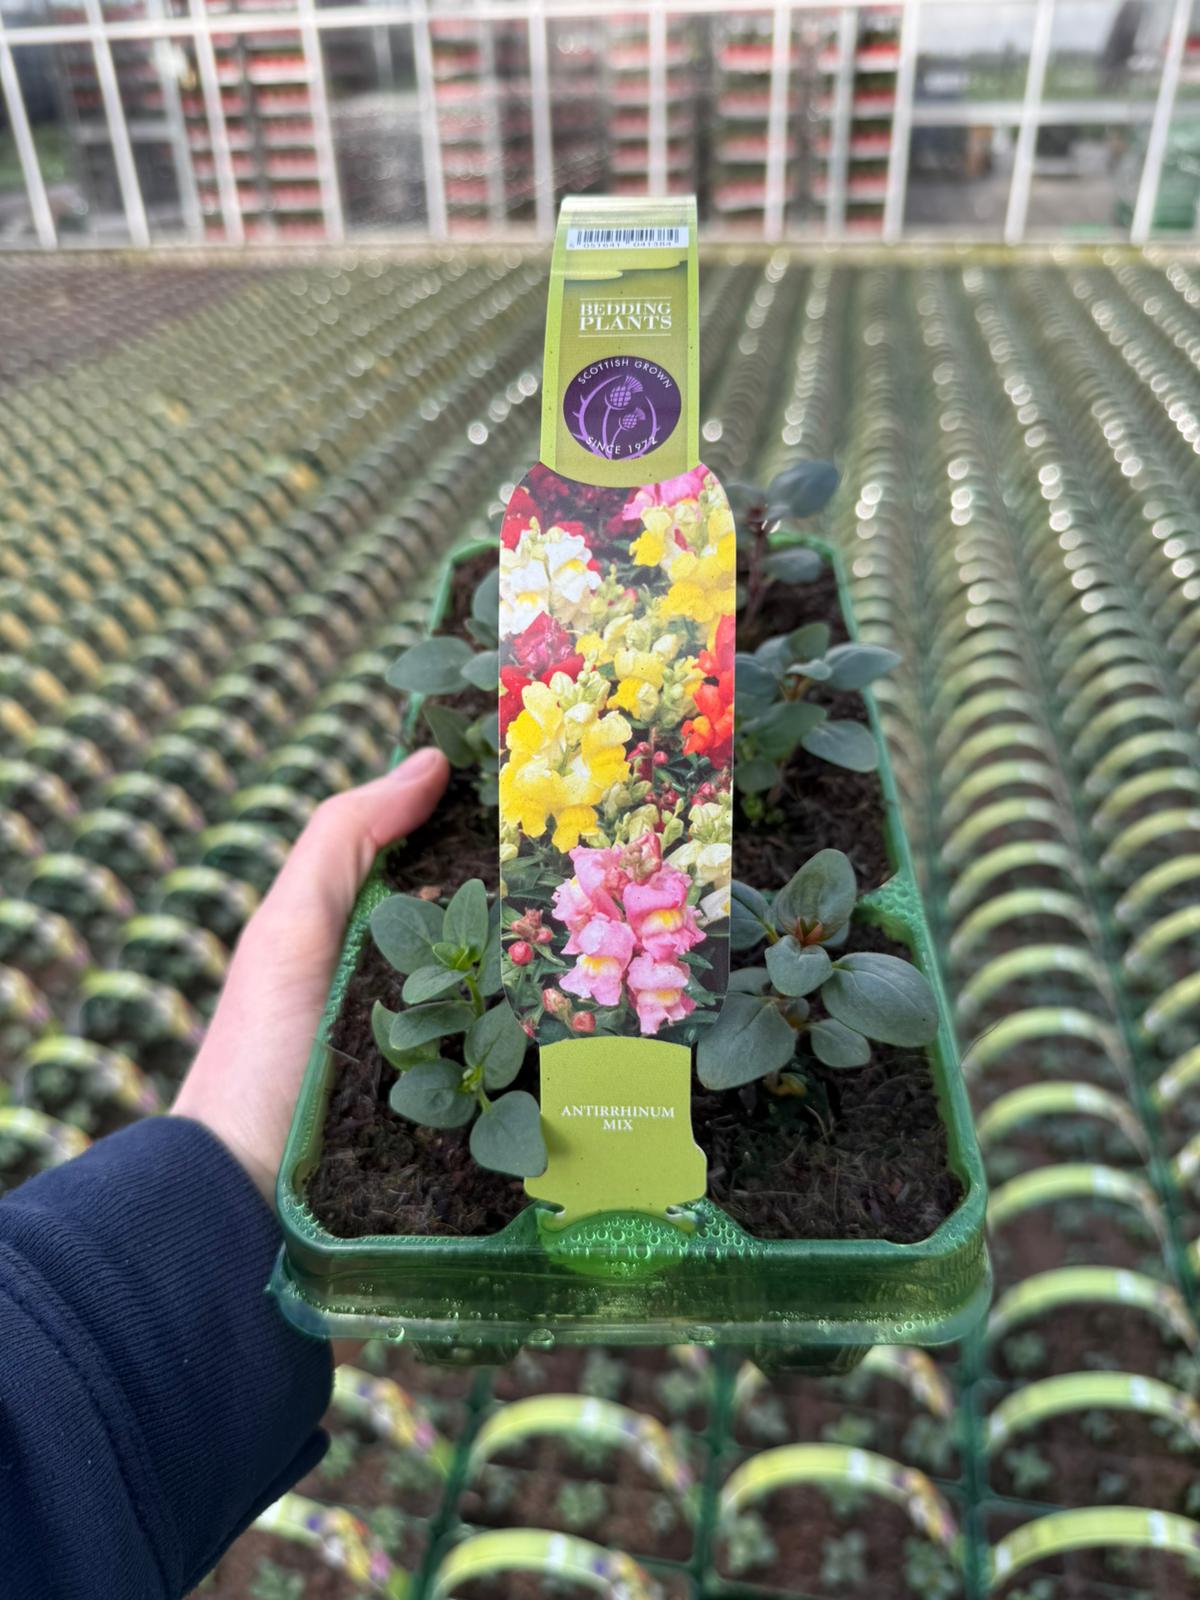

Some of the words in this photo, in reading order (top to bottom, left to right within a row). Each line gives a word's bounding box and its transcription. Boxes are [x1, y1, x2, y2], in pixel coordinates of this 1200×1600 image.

[580, 302, 671, 317] BEDDING
[579, 315, 672, 331] PLANTS
[577, 359, 629, 385] SCOTTISH
[634, 361, 673, 389] GROWN
[586, 436, 621, 455] SINCE
[628, 435, 658, 454] 1972
[561, 1105, 675, 1118] ANTIRRHINUM
[602, 1119, 633, 1131] MIX
